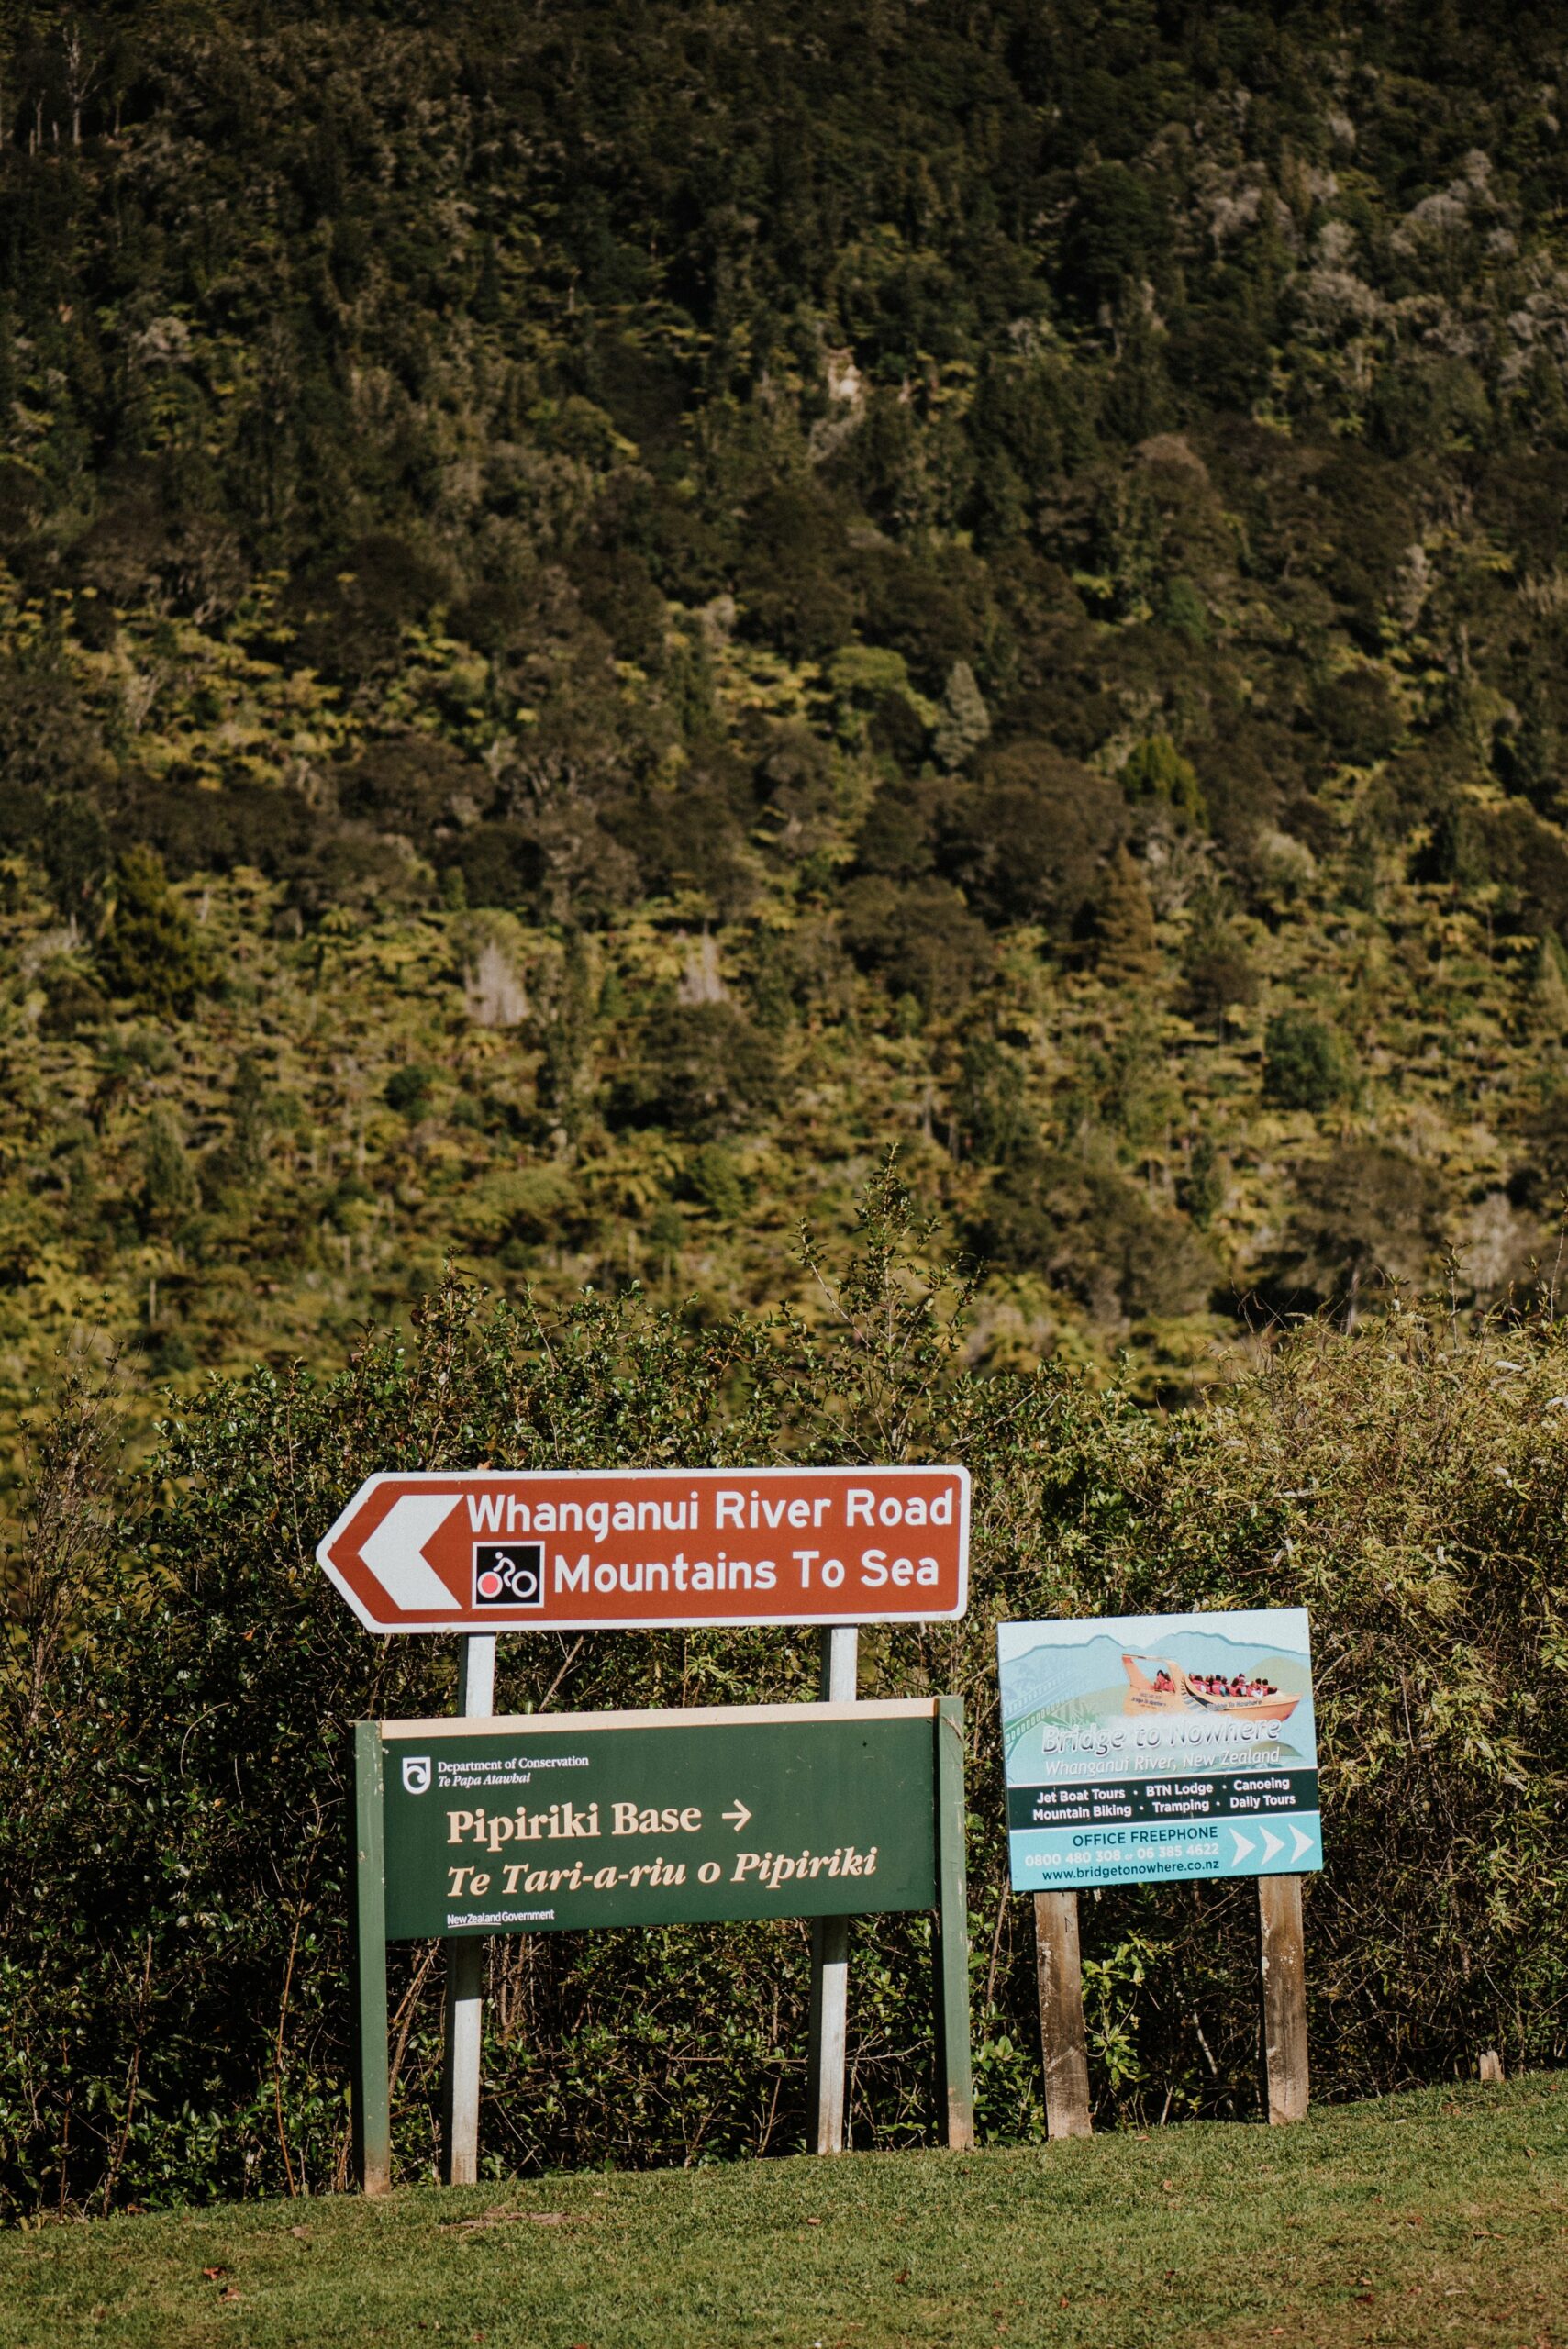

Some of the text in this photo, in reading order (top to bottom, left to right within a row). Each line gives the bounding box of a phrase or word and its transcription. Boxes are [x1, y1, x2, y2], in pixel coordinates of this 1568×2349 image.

[466, 1487, 953, 1543] Whanganui River Road
[554, 1548, 939, 1594] Mountains To Sea
[1041, 1719, 1282, 1758] Bridge to Nowhere
[438, 1755, 589, 1775] Department of Conservation
[1046, 1747, 1280, 1777] Whanganui River, New Zealand
[439, 1772, 531, 1788] Te Papa Atawhai
[1233, 1777, 1290, 1793] Canoeing
[1037, 1787, 1126, 1804] Jet Boat Tours
[1146, 1783, 1214, 1798] BTN Lodge
[1152, 1798, 1210, 1815] Tramping
[1229, 1792, 1296, 1810] Daily Tours
[1032, 1804, 1132, 1821] Mountain Biking
[447, 1801, 702, 1853] Pipiriki Base
[1073, 1826, 1218, 1847] OFFICE FREEPHONE
[1024, 1854, 1062, 1867] 0800
[1065, 1851, 1092, 1865] 480
[1095, 1848, 1121, 1863] 308
[1137, 1847, 1155, 1860] 06
[1158, 1845, 1183, 1859] 385
[1185, 1842, 1219, 1857] 4622
[447, 1846, 878, 1898] Te Tari-a-riu o Pipiriki
[1042, 1860, 1219, 1881] www.bridgetonowhere.co.nz
[447, 1909, 554, 1925] New Zealand Government
